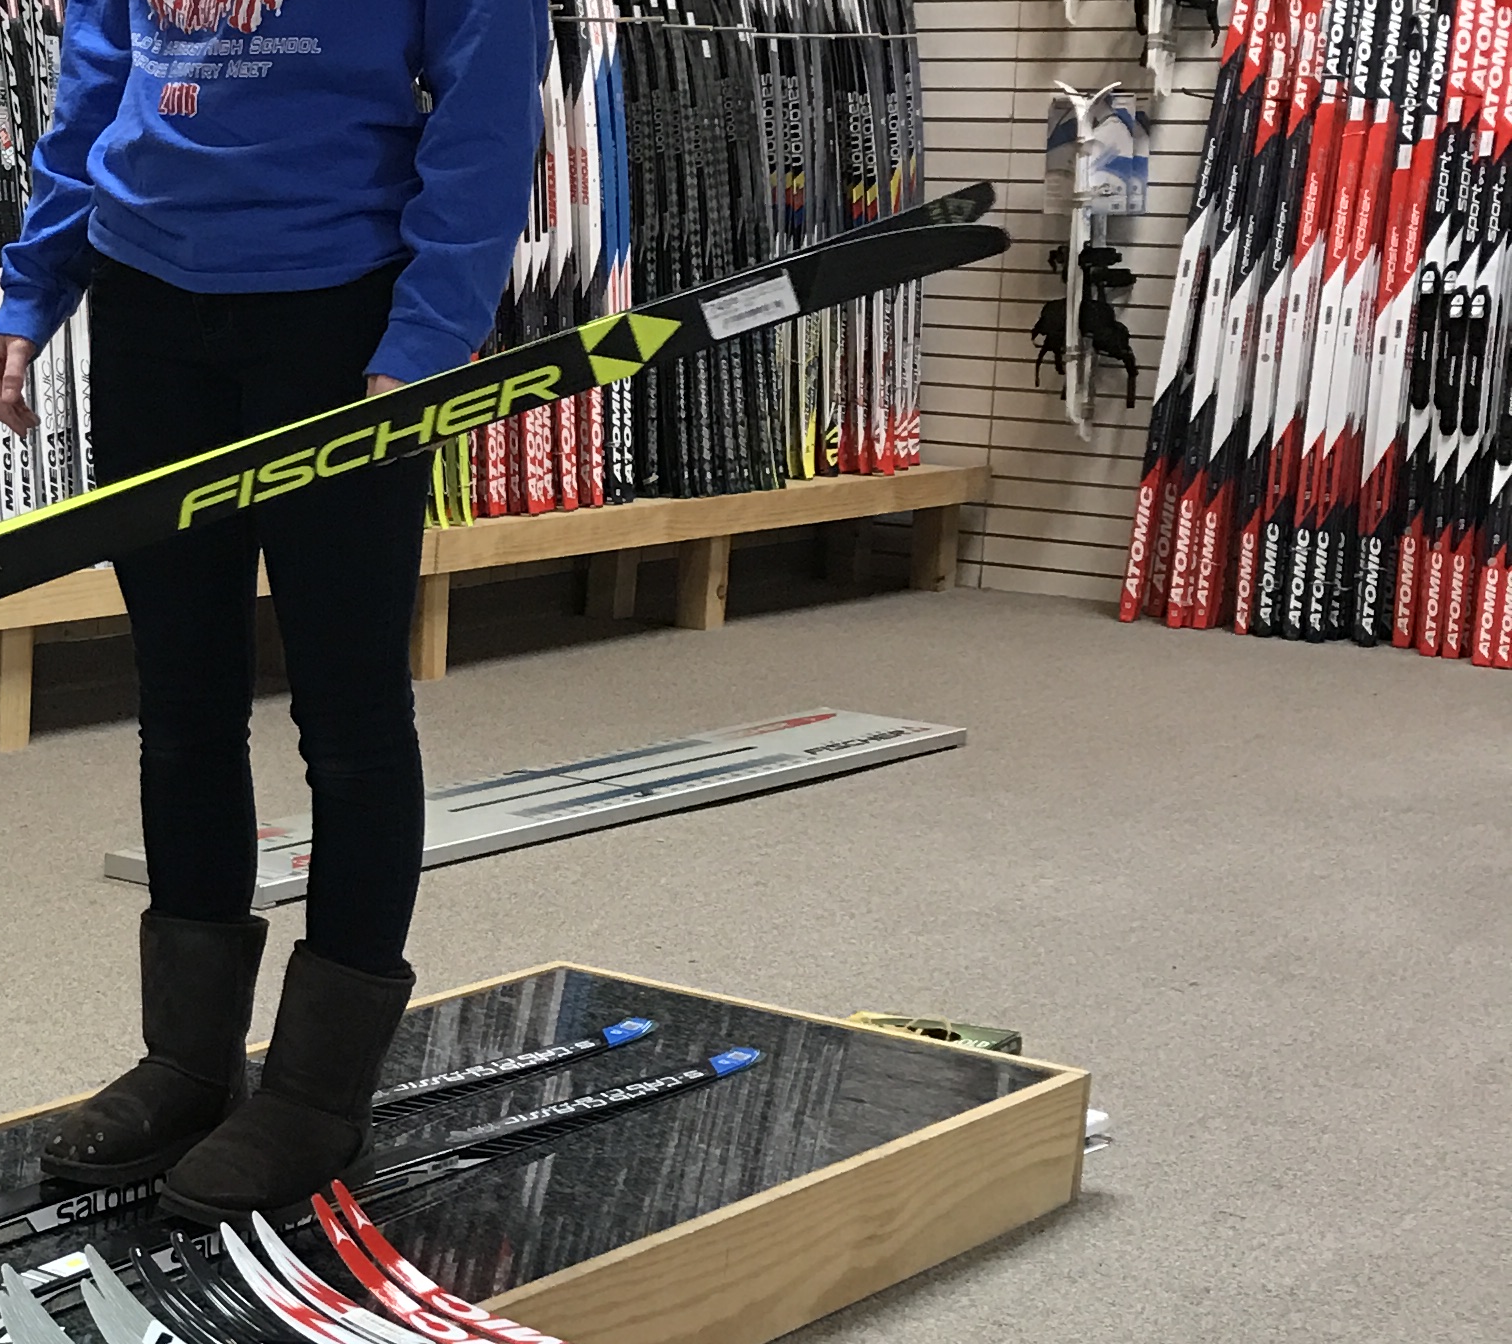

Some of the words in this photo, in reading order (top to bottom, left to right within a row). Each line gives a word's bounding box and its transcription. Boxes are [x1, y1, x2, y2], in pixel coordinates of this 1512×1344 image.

[178, 364, 563, 531] FISCHER
[1125, 485, 1155, 601] ATOMIC
[1235, 531, 1256, 631] ATOMIC
[1396, 535, 1418, 637] ATOMIC
[1424, 551, 1444, 649] ATOMIC
[1448, 554, 1467, 652] ATOMIC
[55, 1173, 168, 1227] salomo
